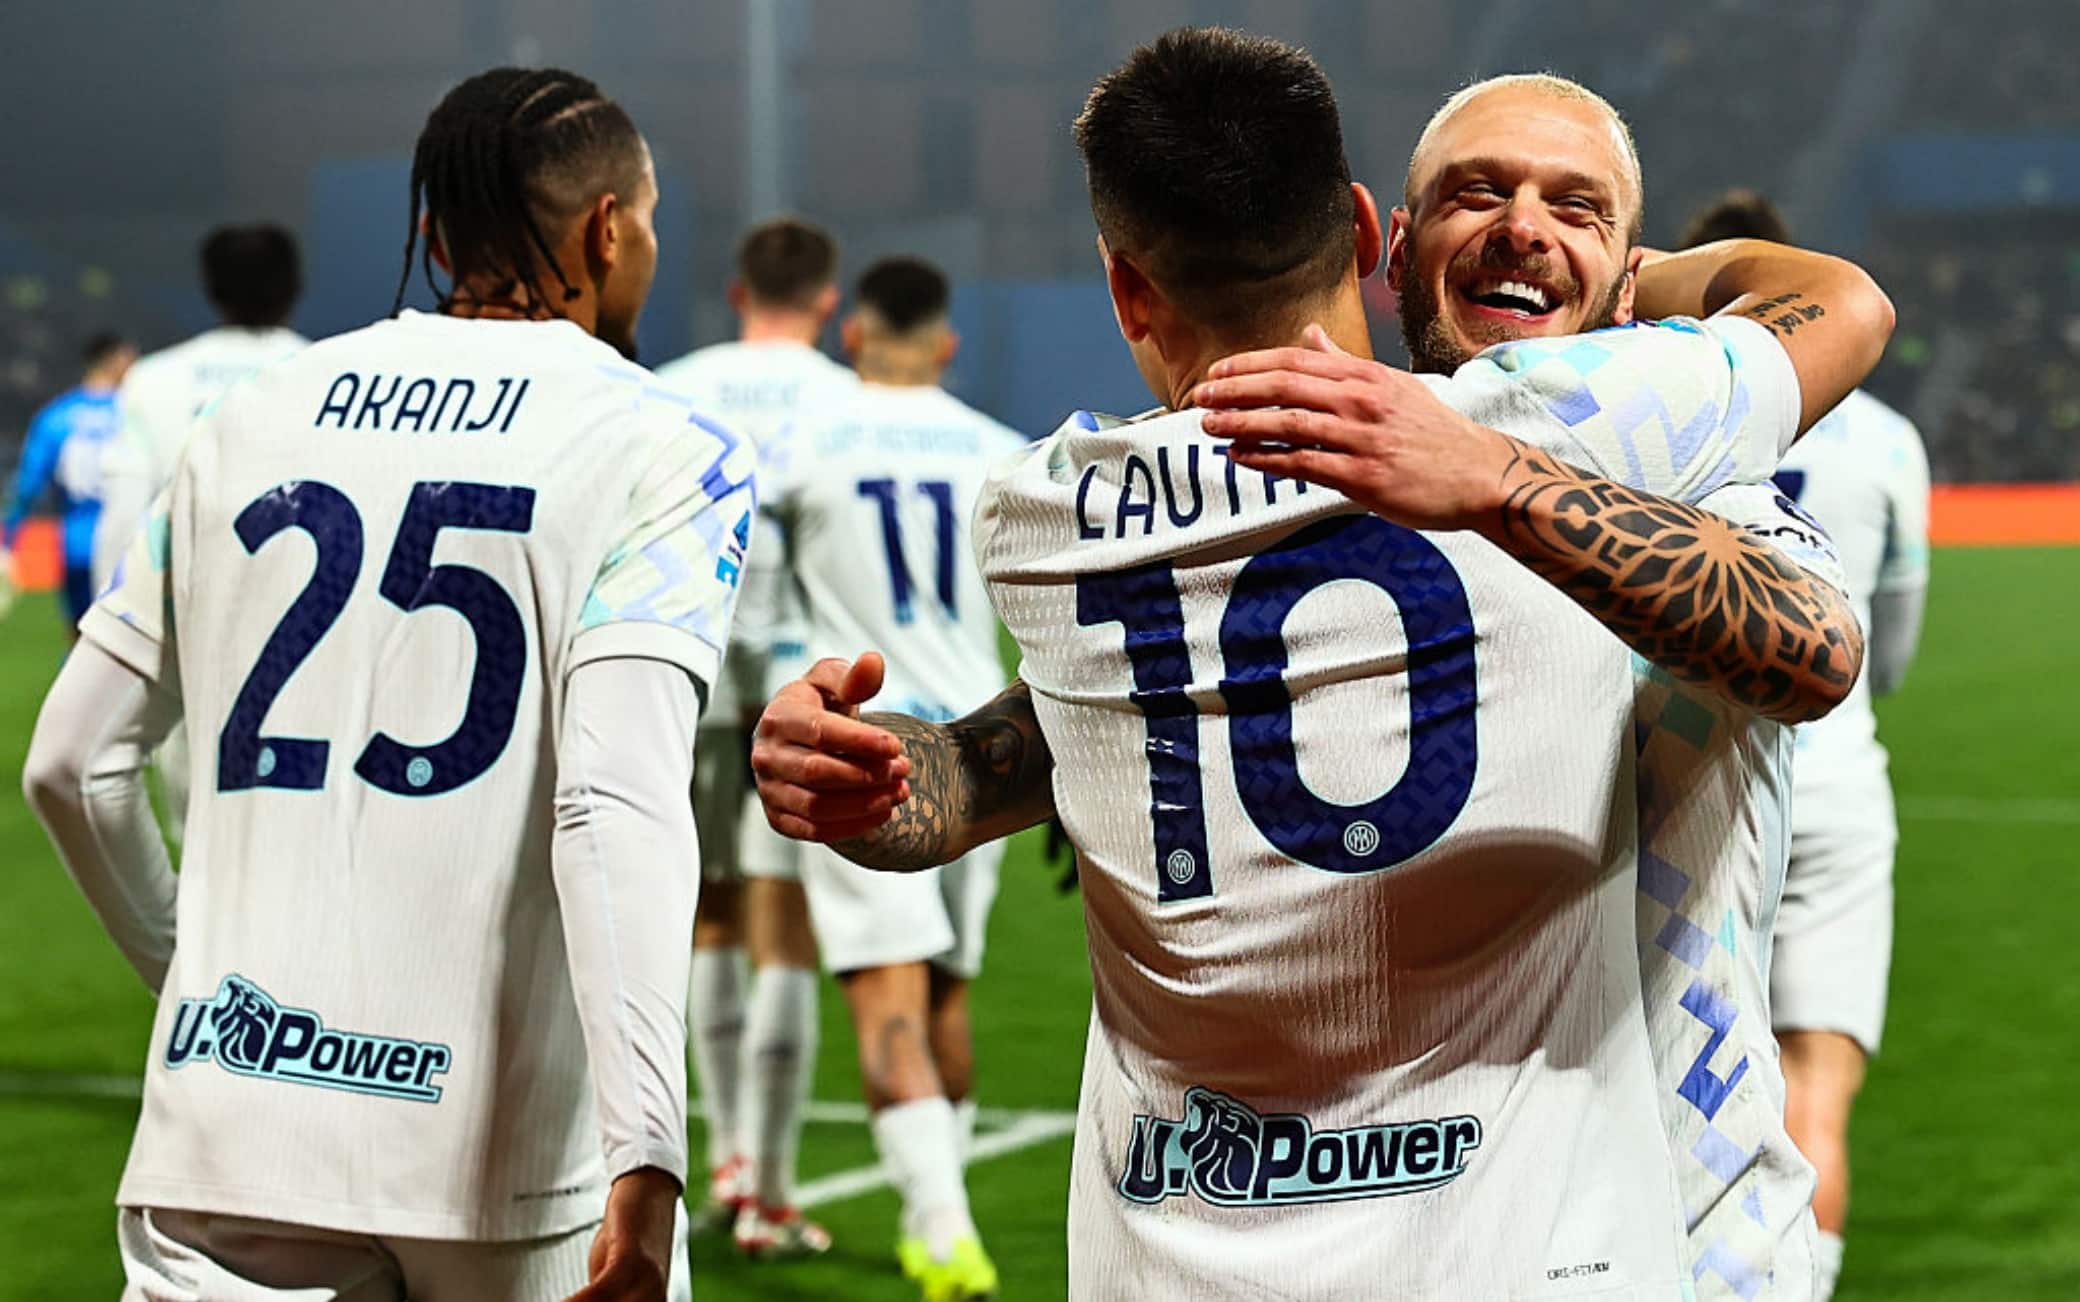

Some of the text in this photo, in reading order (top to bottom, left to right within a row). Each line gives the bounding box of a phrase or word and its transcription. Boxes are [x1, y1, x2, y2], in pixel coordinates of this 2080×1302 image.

[314, 371, 531, 434] AKANJI
[216, 479, 537, 798] 25
[857, 477, 960, 625] 11
[1075, 508, 1481, 904] 10
